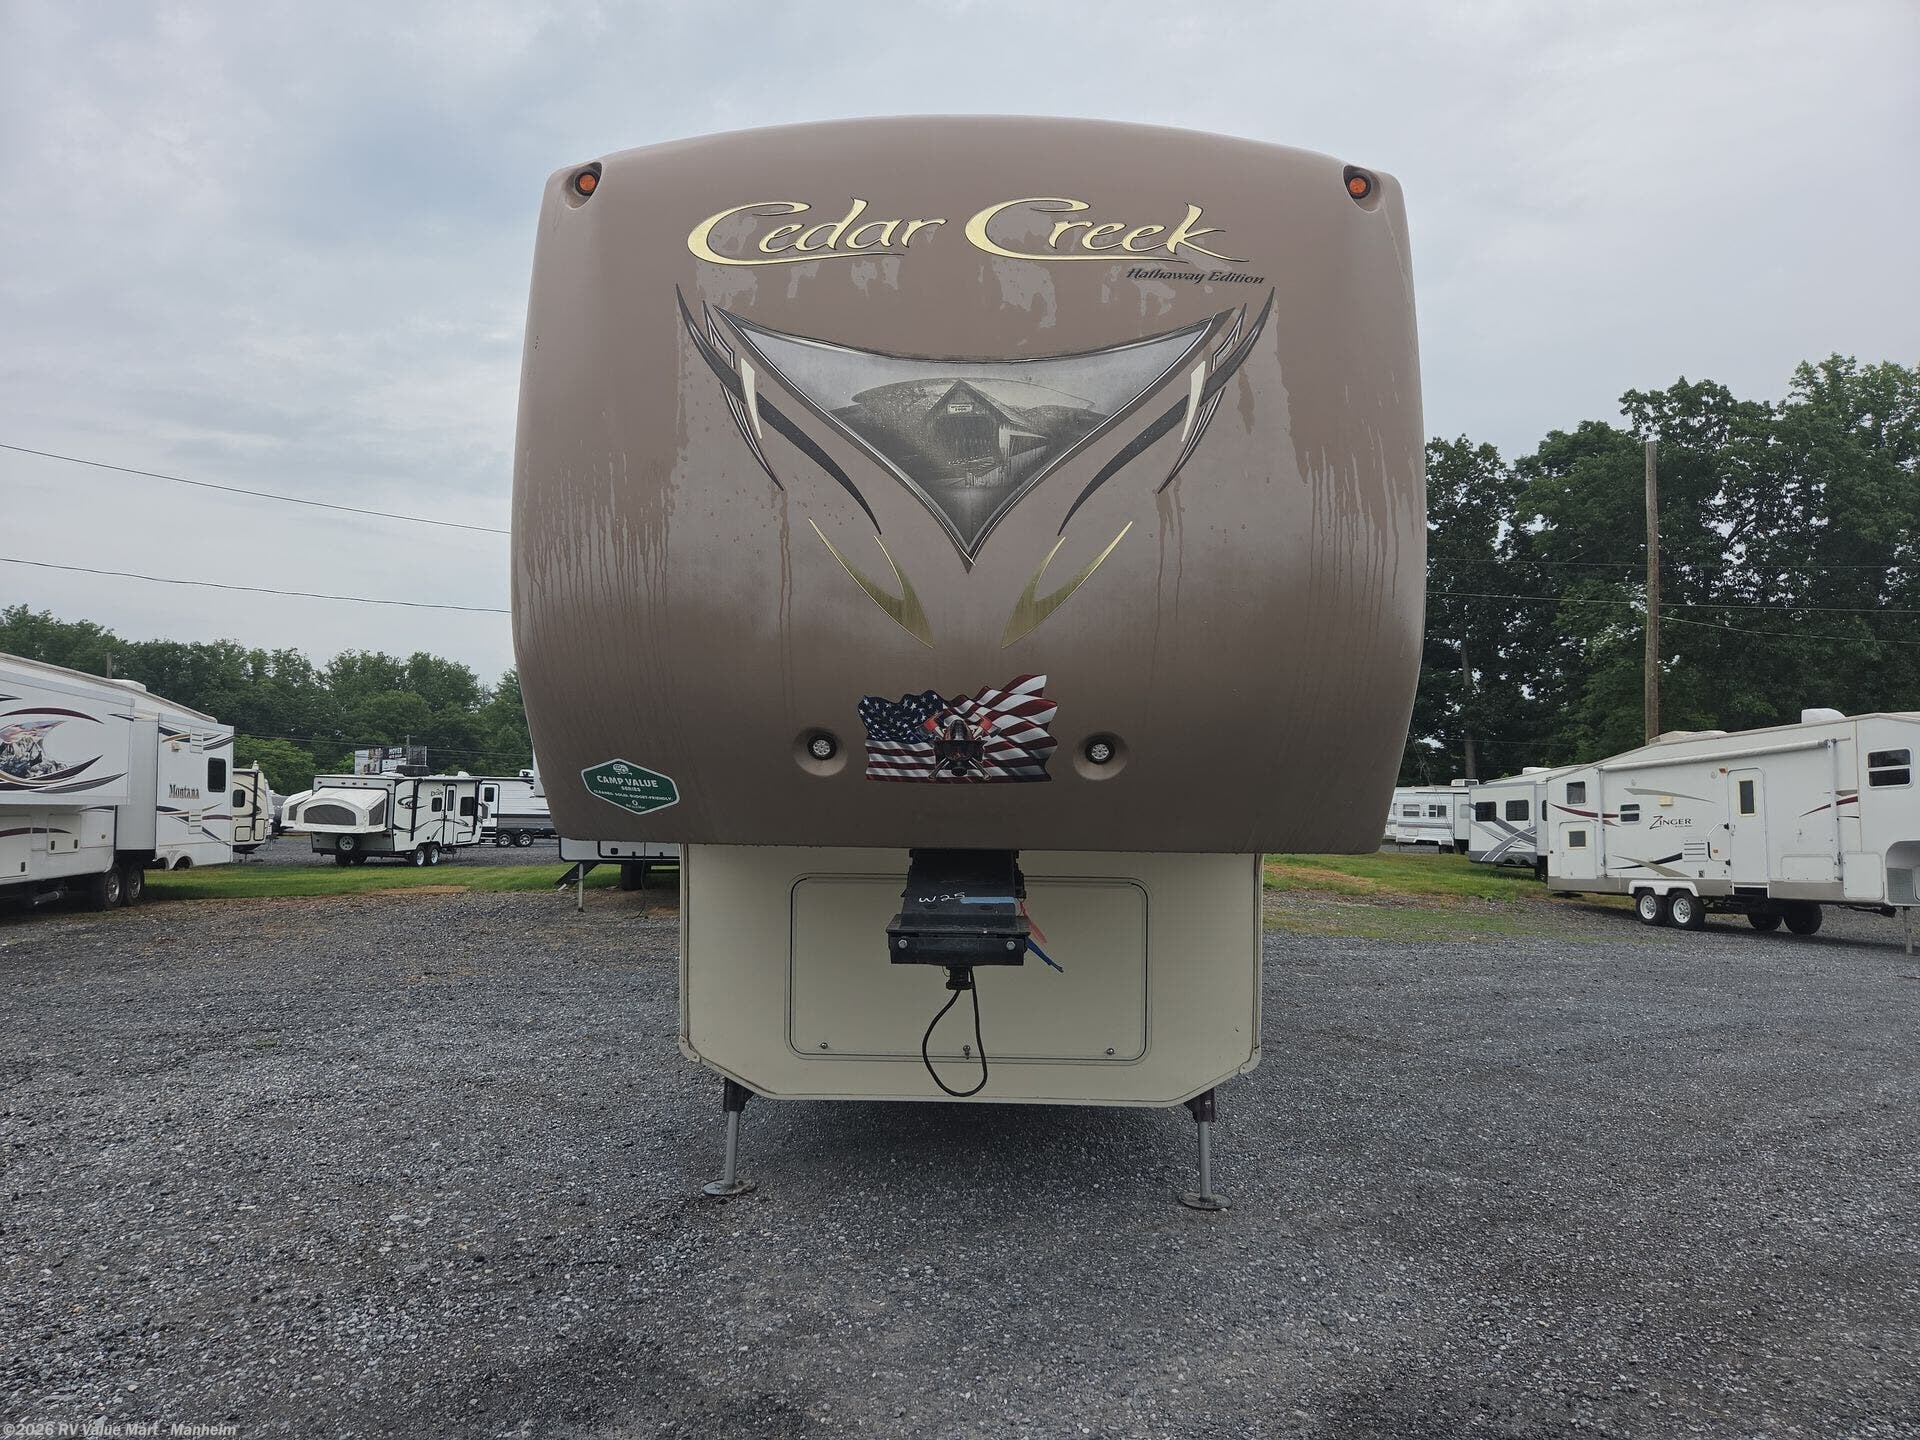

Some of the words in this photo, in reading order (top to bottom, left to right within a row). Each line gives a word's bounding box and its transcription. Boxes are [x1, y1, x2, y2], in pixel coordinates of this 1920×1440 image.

[687, 197, 948, 266] Cedar
[964, 197, 1250, 264] Creek
[1126, 267, 1206, 284] Hathaway
[1208, 271, 1265, 284] Edition
[596, 775, 624, 785] CAMP
[624, 778, 659, 788] VALUE
[168, 784, 200, 799] Montana
[1649, 815, 1691, 829] ZINGER
